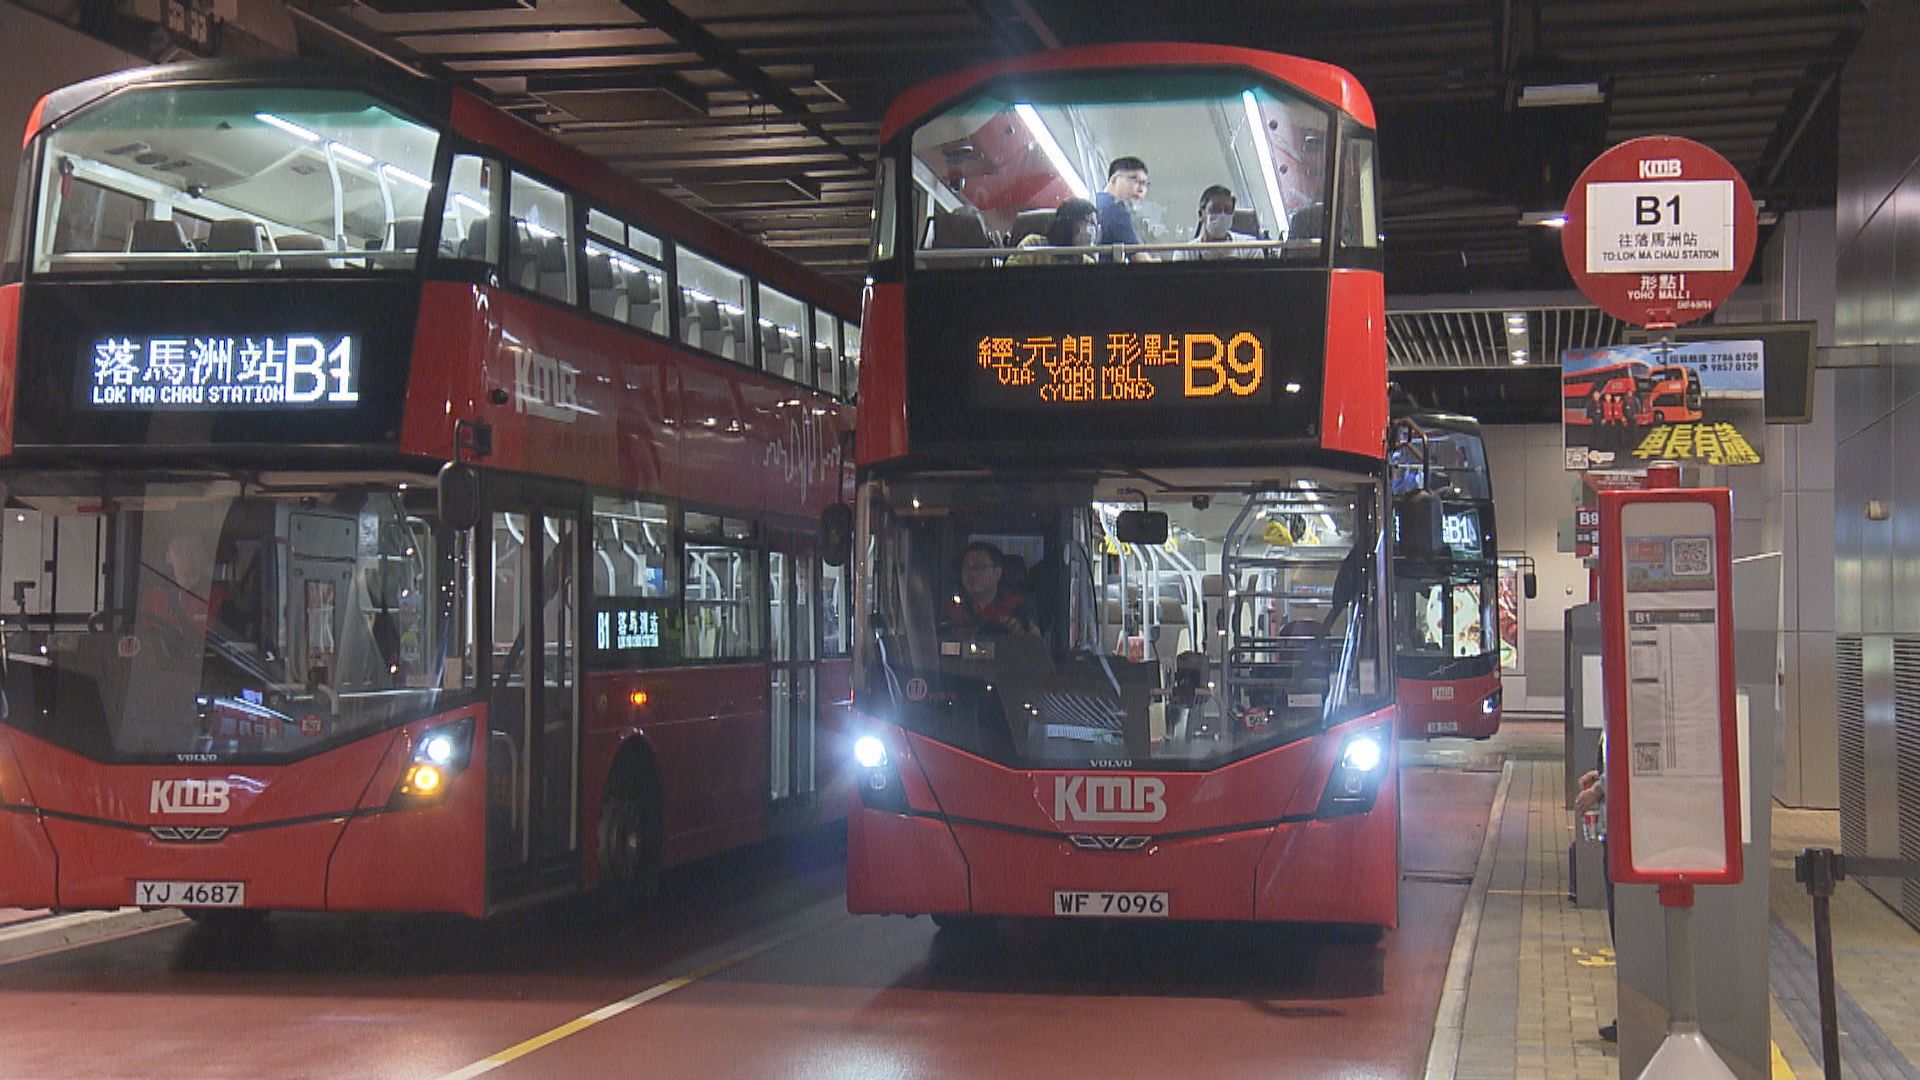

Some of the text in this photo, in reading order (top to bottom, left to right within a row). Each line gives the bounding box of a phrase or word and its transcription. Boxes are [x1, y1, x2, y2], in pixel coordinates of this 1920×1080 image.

[1639, 160, 1682, 179] KMB
[1635, 194, 1681, 226] B1
[1618, 231, 1698, 248] 往落馬洲站
[1638, 250, 1651, 260] MA
[1654, 250, 1680, 260] CHAU
[1682, 249, 1720, 260] STATION
[1627, 289, 1655, 300] YOHO
[1658, 288, 1685, 299] MALL
[1106, 332, 1180, 366] 形點
[94, 337, 286, 386] 落馬洲站
[286, 335, 359, 402] B1
[1184, 331, 1264, 397] B9
[513, 348, 578, 424] KMB
[998, 365, 1148, 386] VIA: YOHO MALL
[93, 384, 285, 403] LOK MA CHAU STATION
[1580, 511, 1599, 526] B9
[1449, 515, 1471, 544] B1
[1635, 612, 1651, 624] B1
[597, 611, 610, 650] B1
[177, 753, 218, 762] VOLVO
[1090, 759, 1132, 768] VOLVO
[150, 779, 231, 814] KMB
[1054, 775, 1167, 823] KMB
[142, 884, 240, 904] YJ 4687
[1059, 893, 1164, 914] WF 7096
